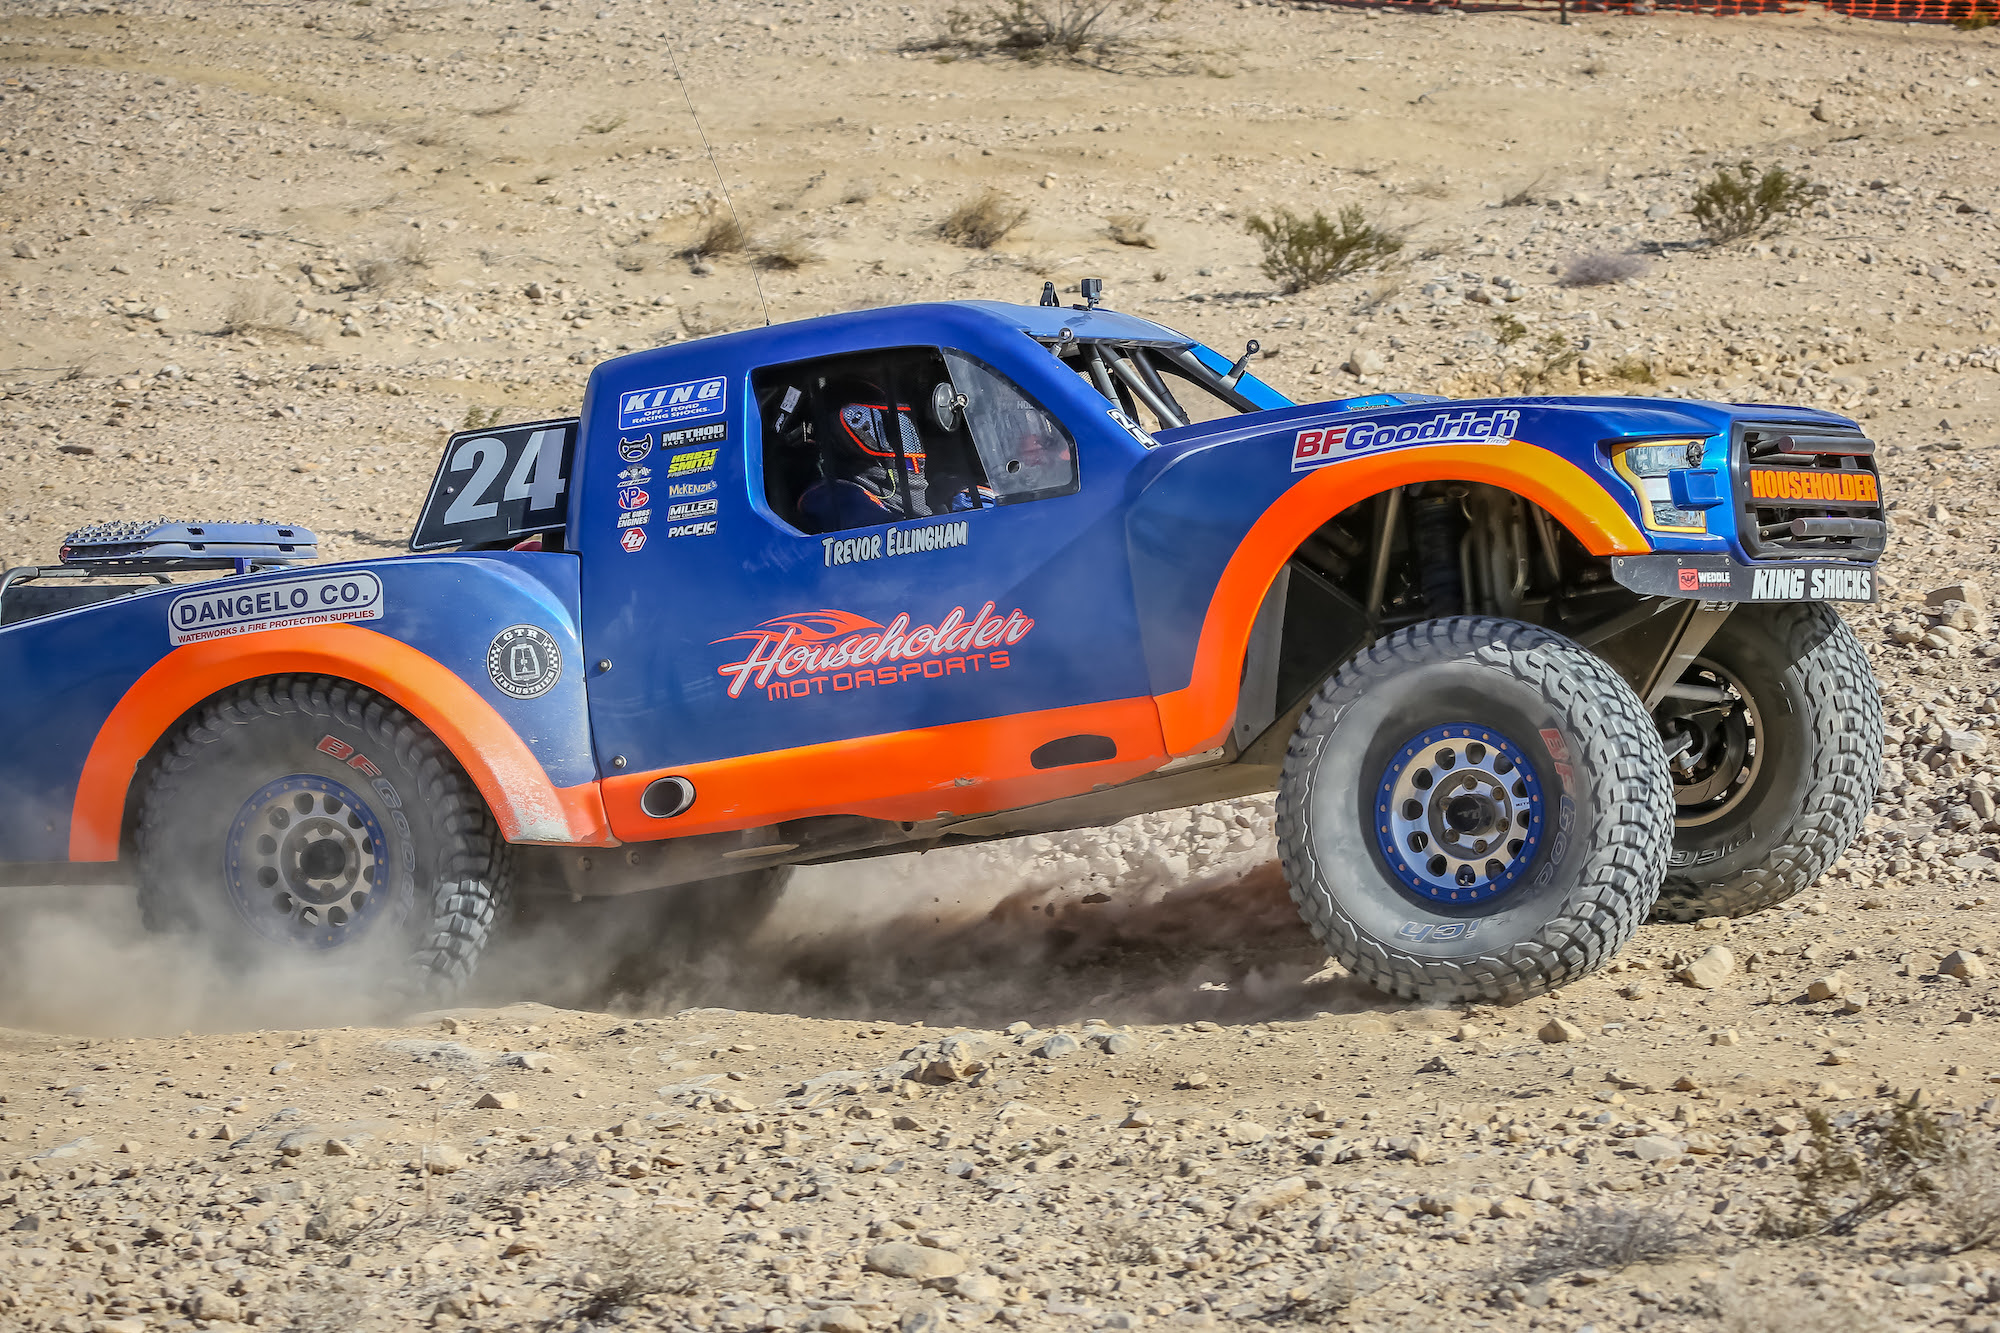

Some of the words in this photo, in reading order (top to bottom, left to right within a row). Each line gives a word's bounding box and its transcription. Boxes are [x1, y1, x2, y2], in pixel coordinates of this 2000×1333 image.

[624, 381, 722, 412] KING
[632, 412, 669, 424] RACING
[670, 406, 708, 418] SHOCKS
[662, 424, 725, 443] METHOD
[688, 432, 725, 443] WHEELS
[1111, 410, 1157, 449] 24
[1295, 410, 1515, 459] BFGoodrich
[668, 455, 716, 474] SMITH
[671, 448, 719, 464] HERBST
[443, 427, 567, 526] 24
[1750, 470, 1877, 502] HOUSEHOLDER
[620, 487, 640, 509] VP
[670, 501, 716, 516] MILLER
[617, 516, 649, 529] ENGINES
[668, 520, 717, 538] PACIFIC
[821, 534, 883, 567] TREVOR
[886, 520, 968, 557] ELLINGHAM
[1698, 571, 1731, 583] WEDDLE
[1752, 568, 1806, 600] KING
[1810, 567, 1871, 600] SHOCKS
[180, 588, 309, 625] DANGELO
[319, 582, 369, 605] CO.
[177, 626, 238, 643] WATERWORKS
[239, 625, 246, 633] &
[248, 621, 267, 632] FIRE
[269, 613, 328, 628] PROTECTION
[330, 609, 375, 622] SUPPLIES
[503, 628, 539, 641] GTR
[717, 601, 1035, 699] Householder
[497, 671, 555, 695] INDUSTRIES
[767, 651, 1010, 701] MOTORSPORTS
